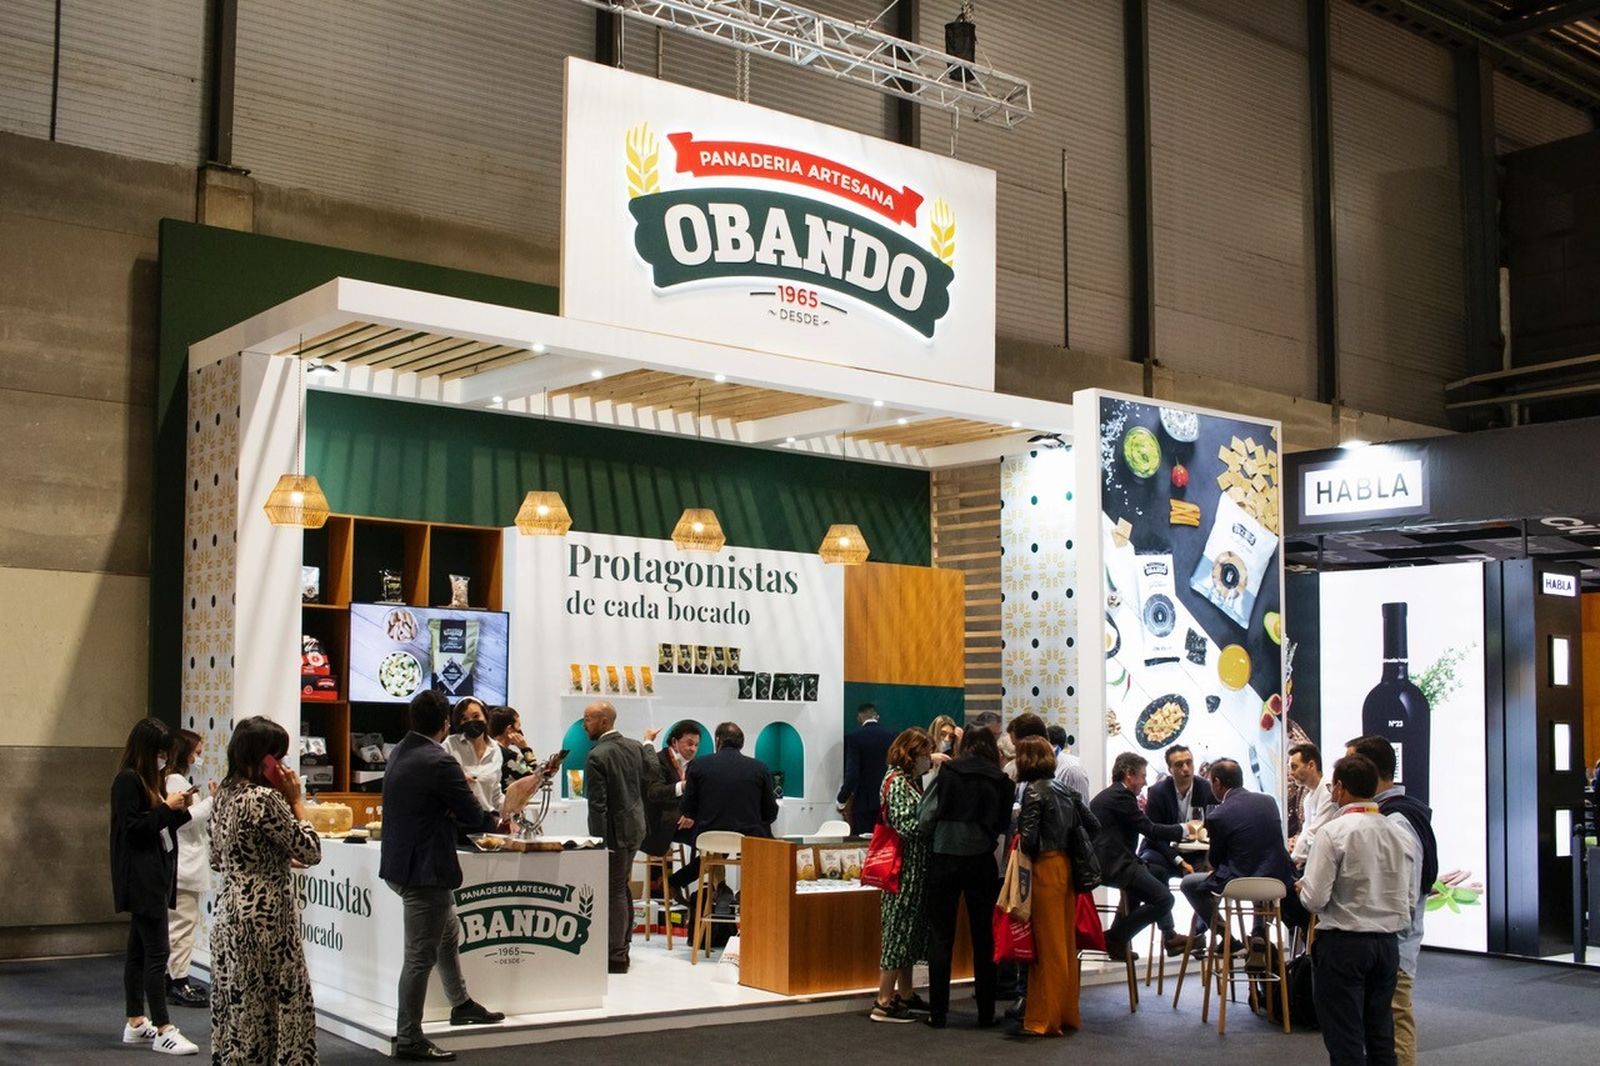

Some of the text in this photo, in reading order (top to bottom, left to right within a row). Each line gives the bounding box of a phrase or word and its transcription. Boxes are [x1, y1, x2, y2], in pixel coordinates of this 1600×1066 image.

[700, 151, 894, 210] PANADERIA ARTESANA
[664, 203, 928, 311] OBANDO
[778, 285, 818, 308] 1965
[779, 308, 819, 326] DESDE
[1317, 473, 1408, 504] HABLA
[568, 544, 799, 595] Protagonistas
[1545, 578, 1572, 591] HABLA
[566, 590, 751, 626] de cada bocado
[460, 886, 562, 901] PANADERIA ARTESANA
[299, 913, 343, 951] bocado
[498, 947, 520, 957] 1965
